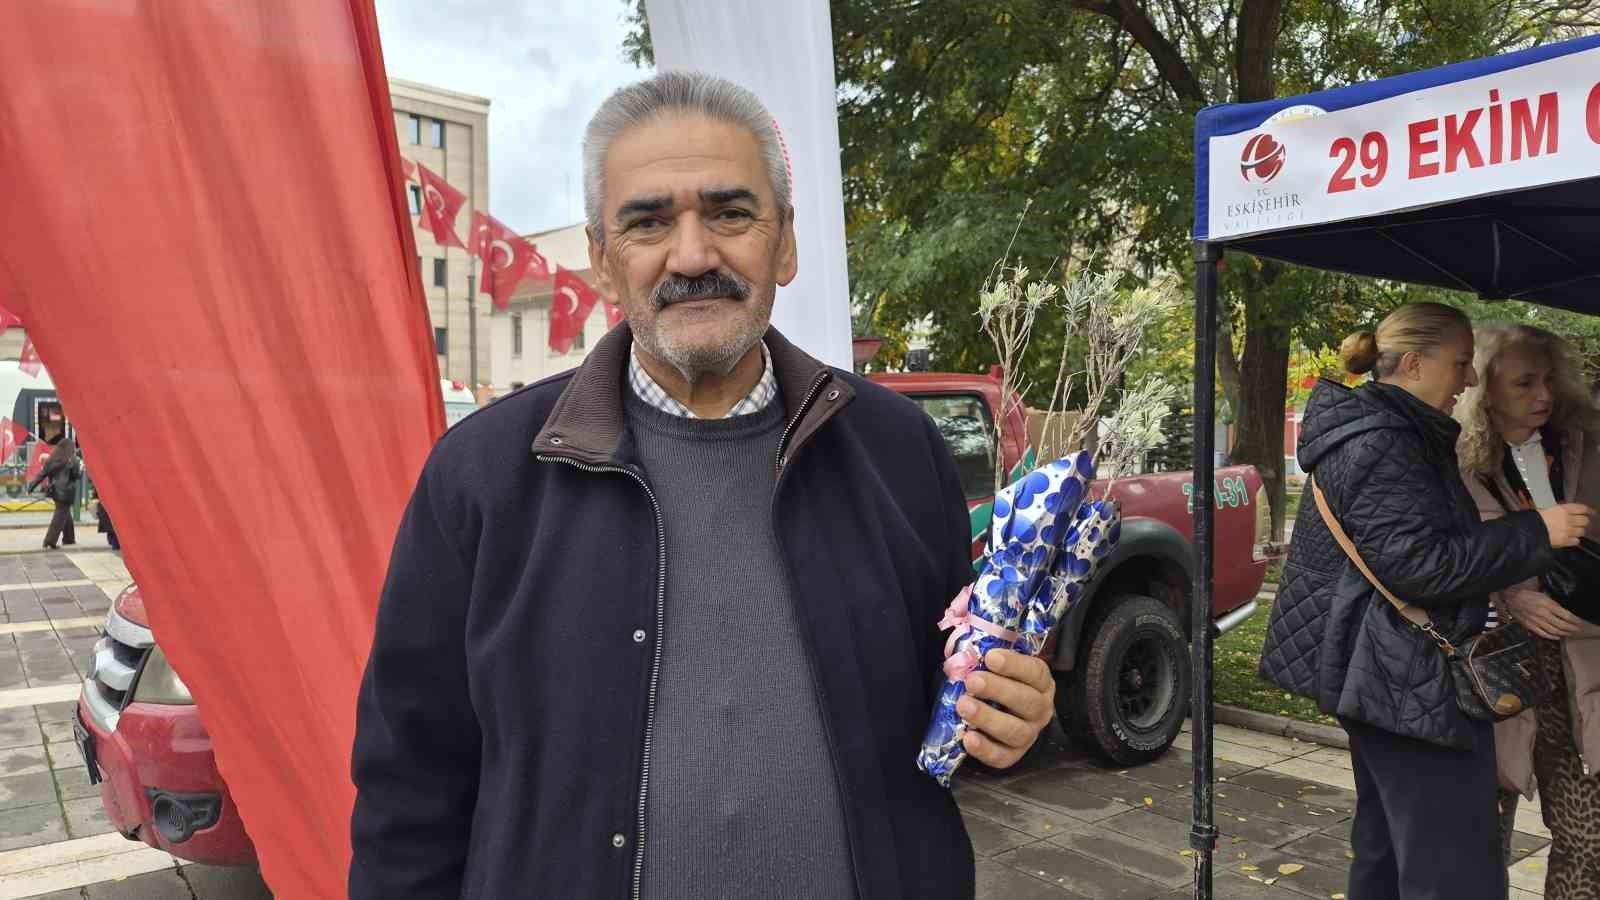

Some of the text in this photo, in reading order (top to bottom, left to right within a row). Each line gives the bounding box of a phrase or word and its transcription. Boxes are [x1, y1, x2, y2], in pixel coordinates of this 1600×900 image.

[1327, 130, 1389, 194] 29
[1407, 87, 1560, 181] EKİM
[1226, 192, 1302, 217] ESKİŞEHİR
